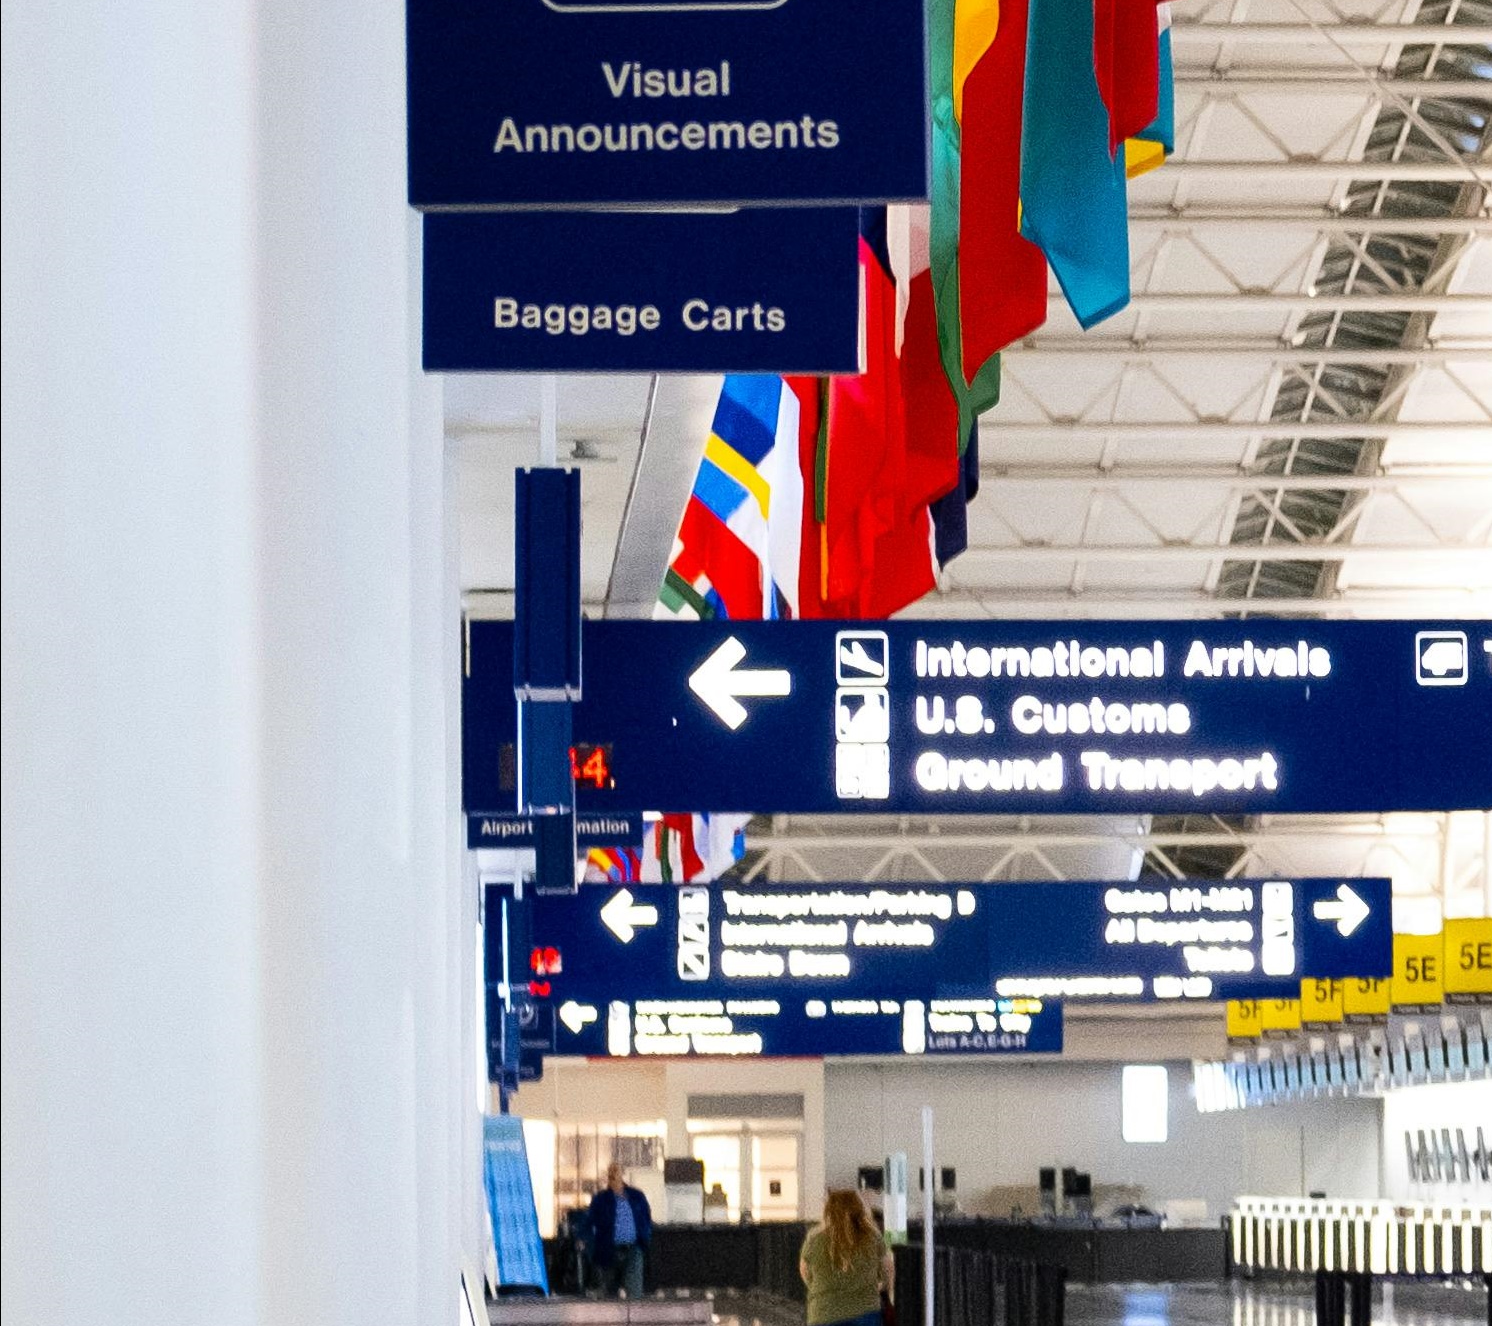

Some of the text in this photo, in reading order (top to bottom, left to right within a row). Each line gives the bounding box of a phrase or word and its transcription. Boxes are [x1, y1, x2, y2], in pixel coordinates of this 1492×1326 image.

[602, 61, 731, 98] Visual
[493, 116, 840, 154] Announcements
[494, 298, 786, 336] Baggage Carts
[915, 640, 1331, 678] International Arrivals
[915, 696, 1191, 734] U.S. Customs
[915, 752, 1278, 796] Ground Transport
[481, 818, 630, 838] Airport mation
[1405, 956, 1436, 982] 5E
[1459, 942, 1492, 971] 5E
